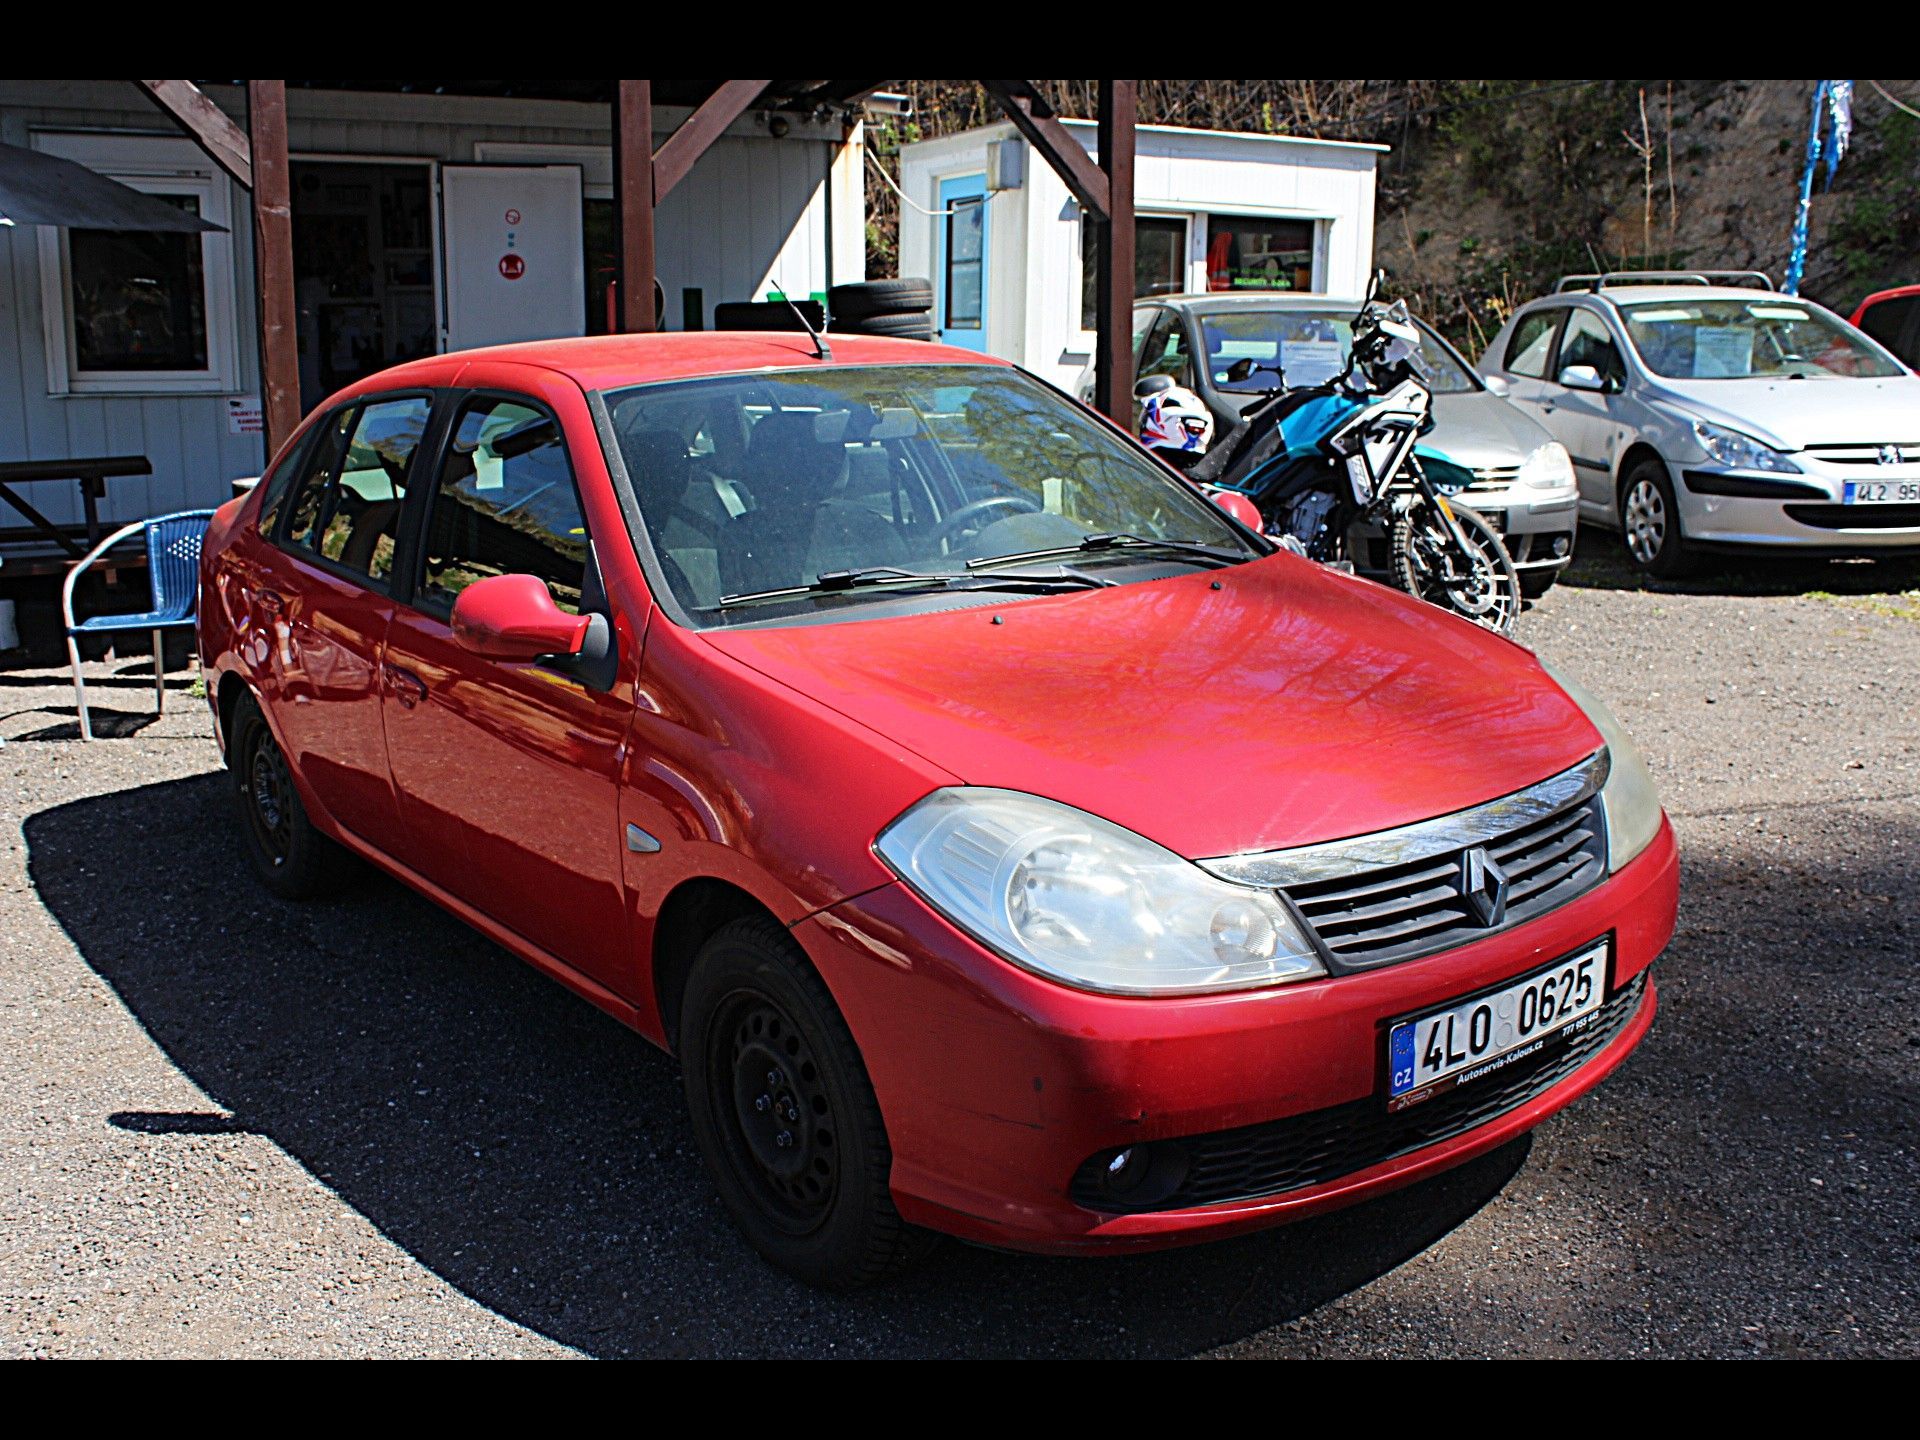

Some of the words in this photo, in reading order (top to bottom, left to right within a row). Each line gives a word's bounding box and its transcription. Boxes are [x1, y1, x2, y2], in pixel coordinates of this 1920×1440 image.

[1858, 484, 1887, 501] 4L2
[1898, 484, 1920, 501] 95
[1518, 956, 1595, 1037] 0625
[1456, 1040, 1544, 1086] Autoservis-Kalous.cz
[1562, 1022, 1575, 1037] 777
[1394, 1066, 1412, 1087] CZ
